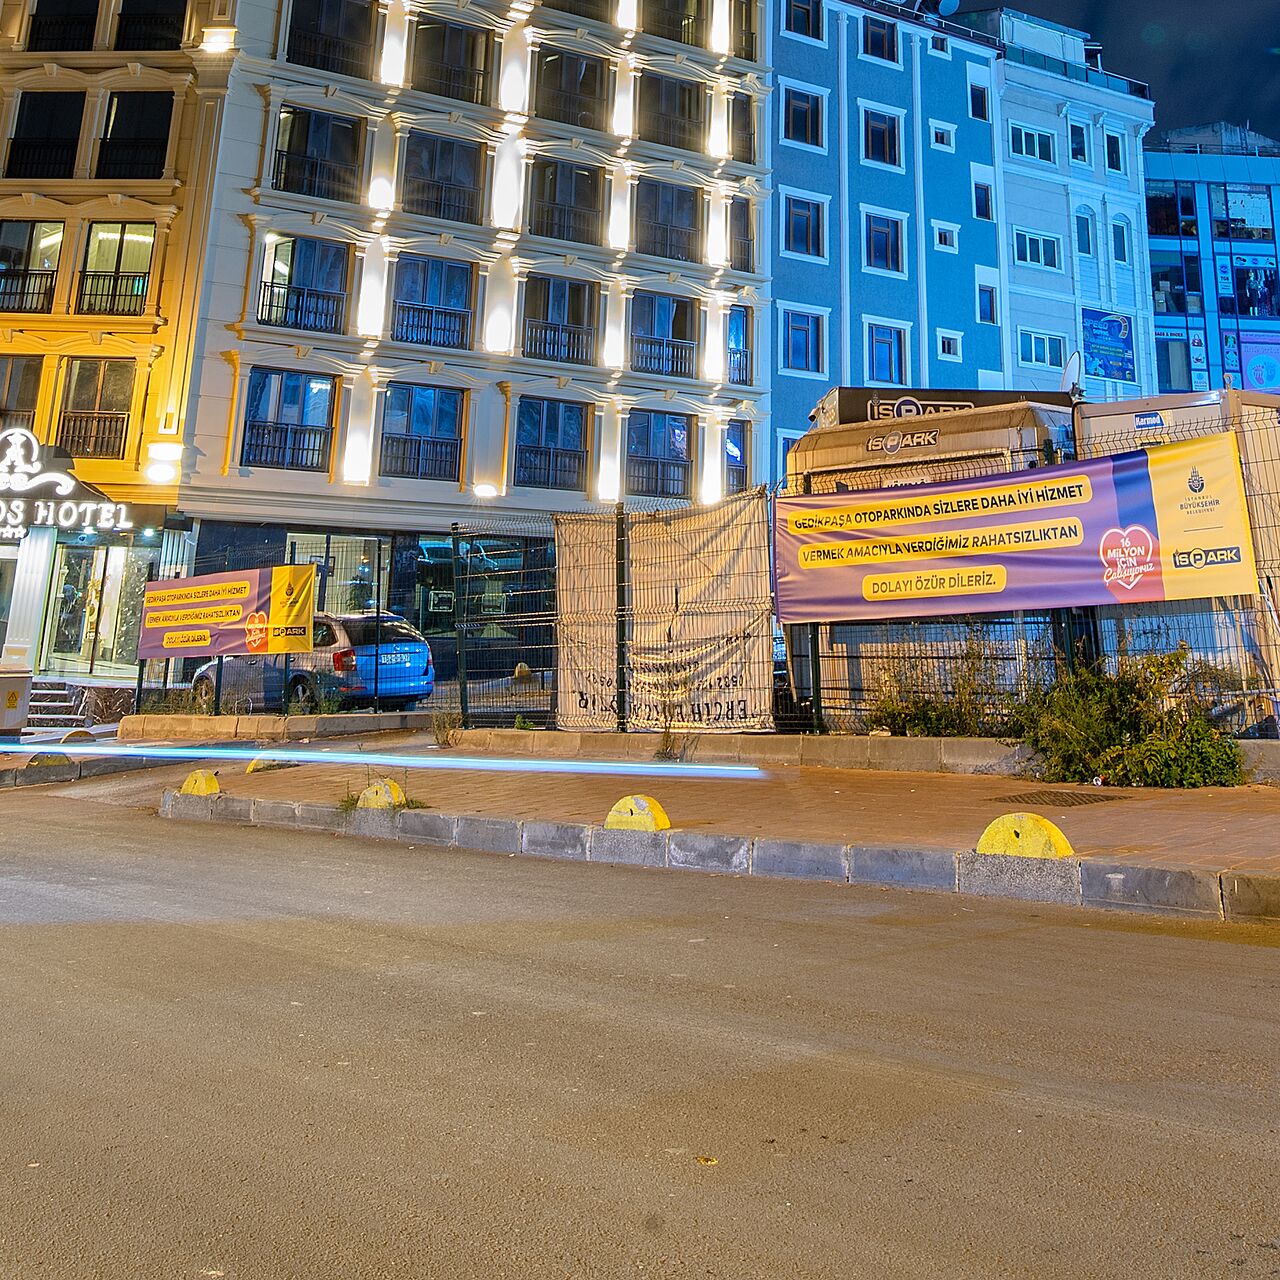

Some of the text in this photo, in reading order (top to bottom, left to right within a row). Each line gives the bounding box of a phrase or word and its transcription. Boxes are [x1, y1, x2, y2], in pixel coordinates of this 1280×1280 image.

[34, 501, 134, 528] HOTEL
[795, 484, 1084, 530] GEDİKPAŞA OTOPARKINDA SİZLERE DAHA İYİ HİZMET
[1179, 499, 1220, 511] BÜYÜKŞEHİR
[803, 524, 1078, 563] VERMEK AMACIYLA VERDİĞİMİZ RAHATSIZLIKTAN
[1107, 546, 1145, 559] MİLYON
[1120, 538, 1131, 548] 16
[1116, 557, 1137, 569] İÇİN
[872, 570, 996, 594] DOLAYI ÖZÜR DİLERİZ.
[692, 700, 750, 721] ERCİH
